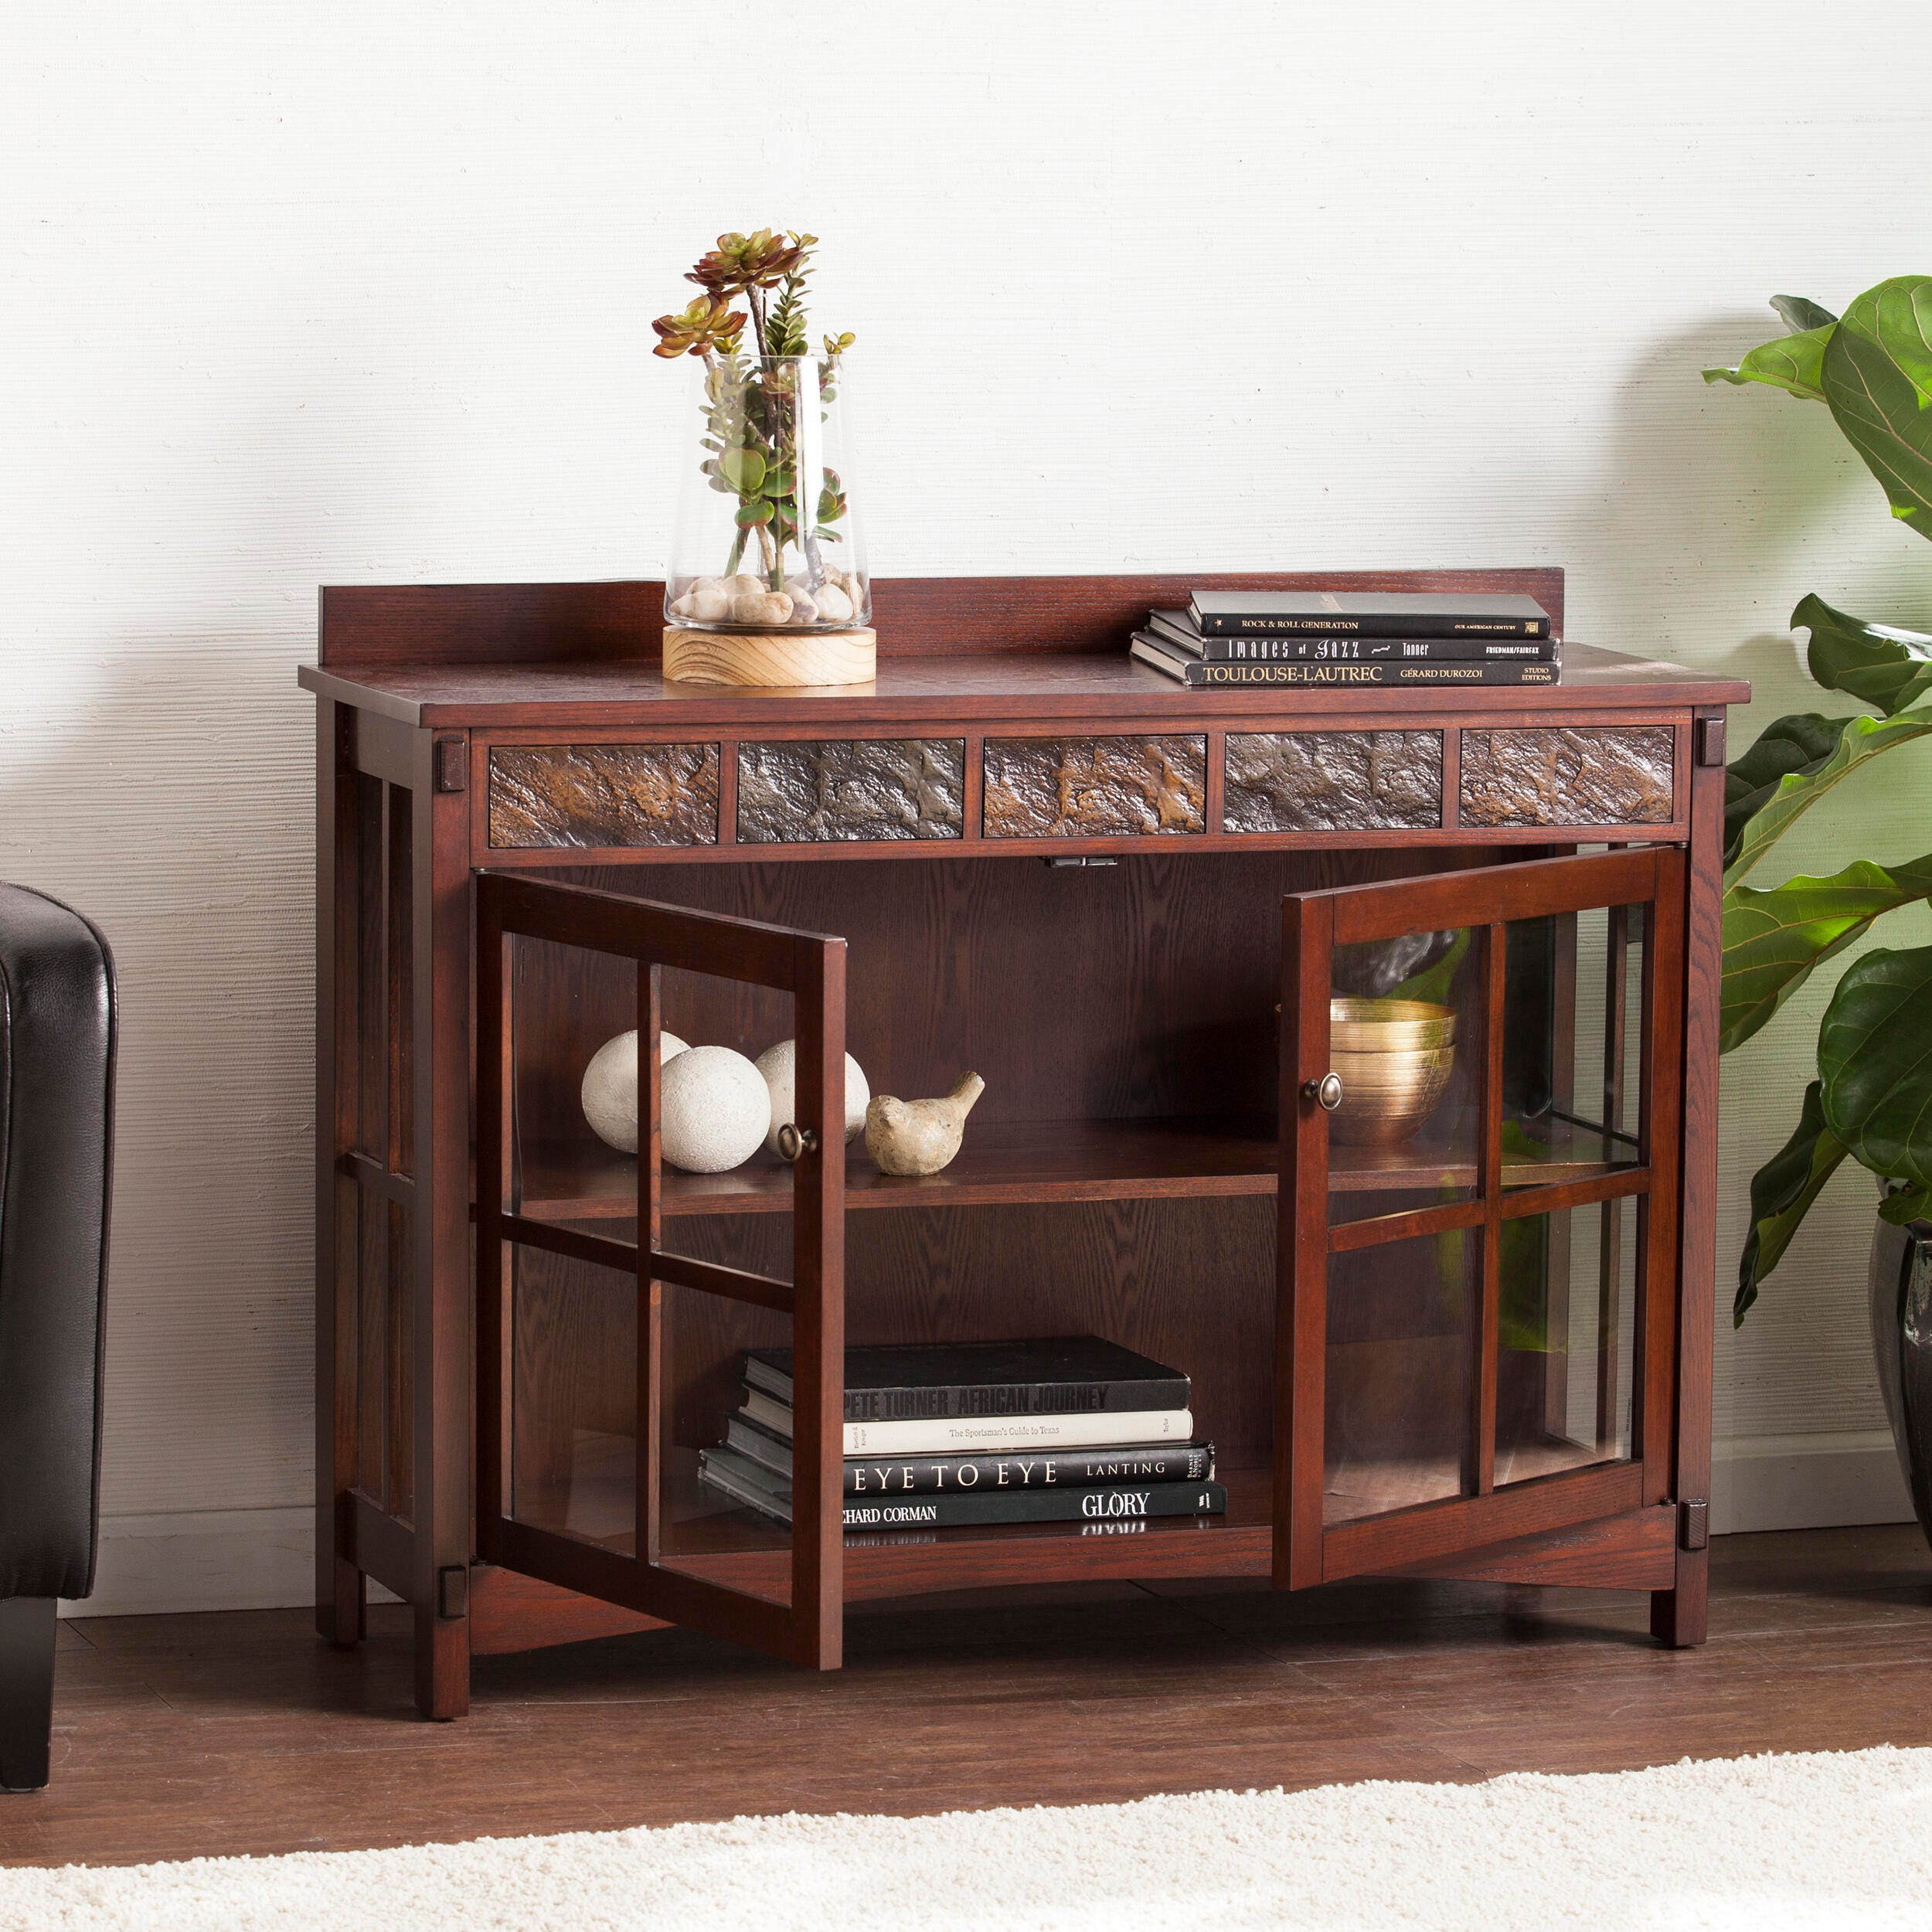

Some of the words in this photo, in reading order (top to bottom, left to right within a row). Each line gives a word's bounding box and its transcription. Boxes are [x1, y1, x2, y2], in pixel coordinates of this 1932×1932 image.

[1301, 621, 1359, 630] GENERATION
[1229, 639, 1288, 659] Images
[1298, 644, 1307, 655] of
[1315, 639, 1359, 659] Jazz
[1403, 642, 1430, 656] Tanner
[1485, 646, 1539, 655] FRIEDMAN/FAIRFAX
[1400, 667, 1438, 678] GÉRARD
[1439, 669, 1482, 678] DUROZOI
[884, 1390, 949, 1417] TURNER
[957, 1387, 1029, 1414] AFRICAN
[1034, 1384, 1110, 1412] JOURNEY
[964, 1427, 1007, 1438] Sportsman's
[1009, 1427, 1029, 1435] Guide
[1039, 1426, 1060, 1434] Texas
[853, 1467, 914, 1491] EYE
[931, 1464, 979, 1488] TO
[997, 1461, 1056, 1485] EYE
[1087, 1461, 1165, 1476] LANTING
[1082, 1492, 1151, 1517] GLORY
[883, 1505, 937, 1522] CORMAN
